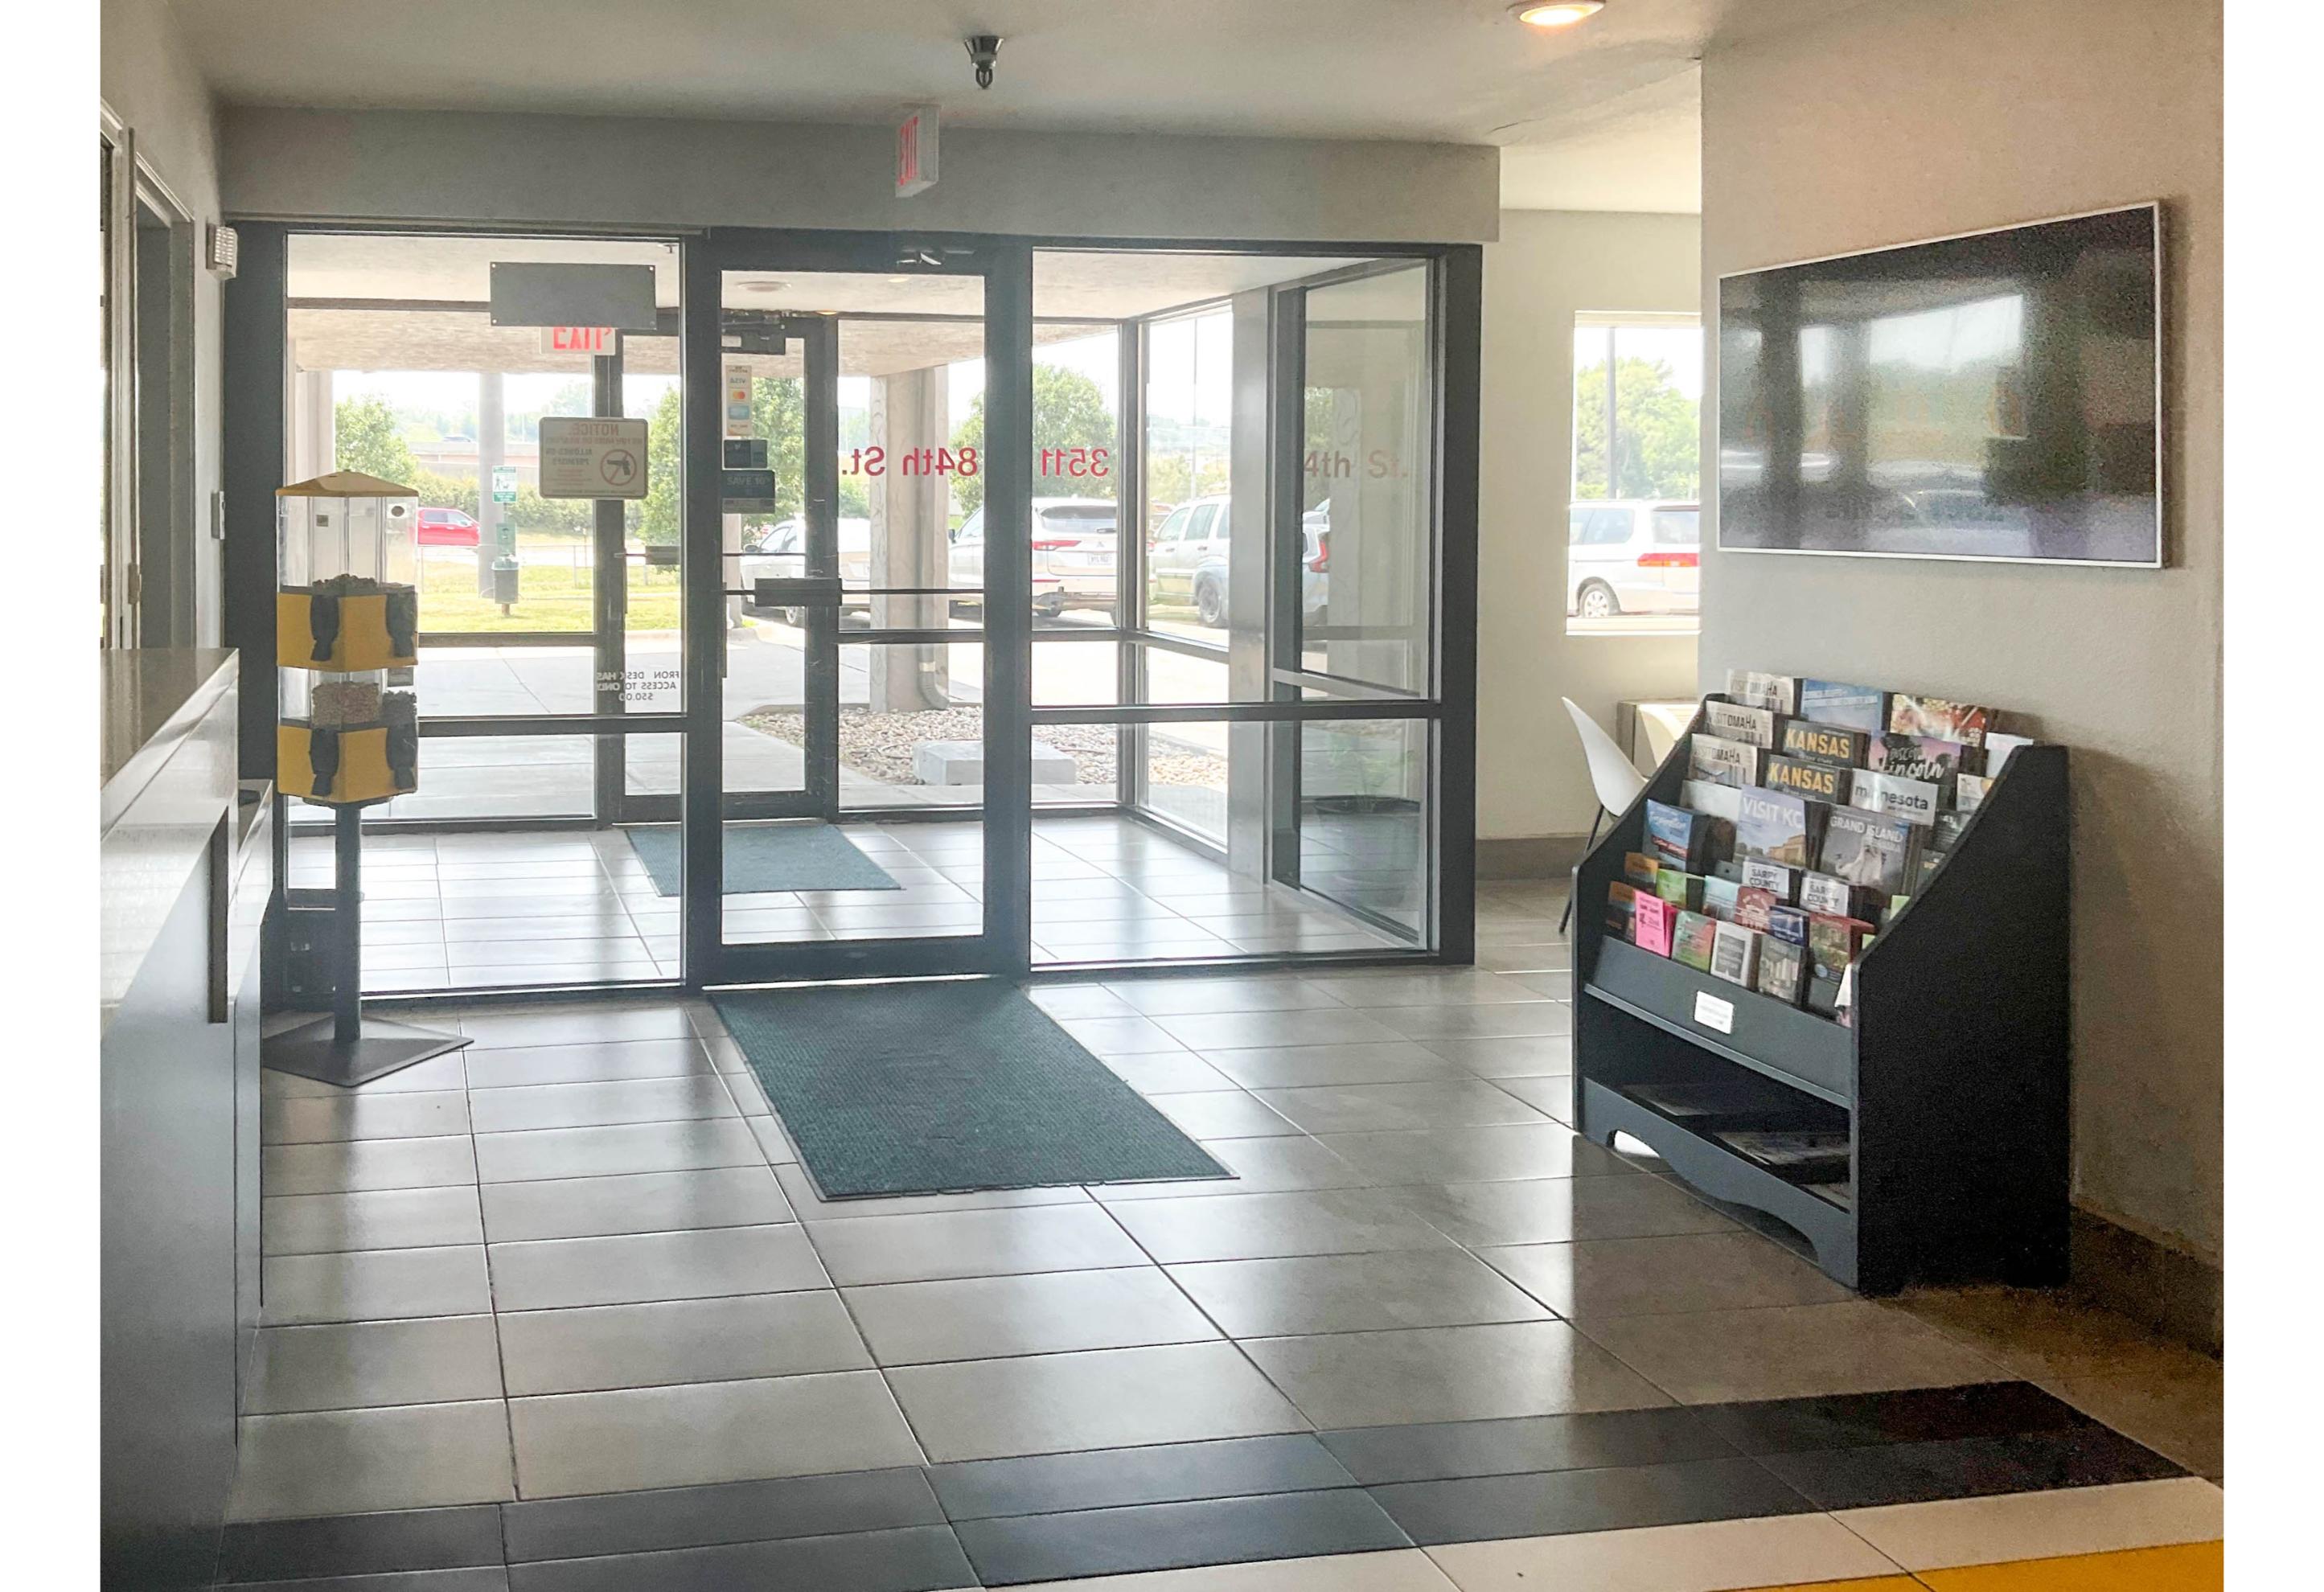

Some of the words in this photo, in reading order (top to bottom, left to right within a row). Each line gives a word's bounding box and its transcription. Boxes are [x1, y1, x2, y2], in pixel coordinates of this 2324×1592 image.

[726, 477, 753, 486] SAVE
[1785, 728, 1850, 759] KANSAS
[1768, 761, 1833, 794] KANSAS
[1854, 785, 1928, 810] mnesota
[1743, 796, 1780, 822] VISIT
[1780, 806, 1804, 829] KC
[1829, 815, 1866, 834] GRAND
[1866, 824, 1904, 843] ISLAND
[1751, 868, 1778, 880] SARPY
[1807, 892, 1840, 907] COUNY
